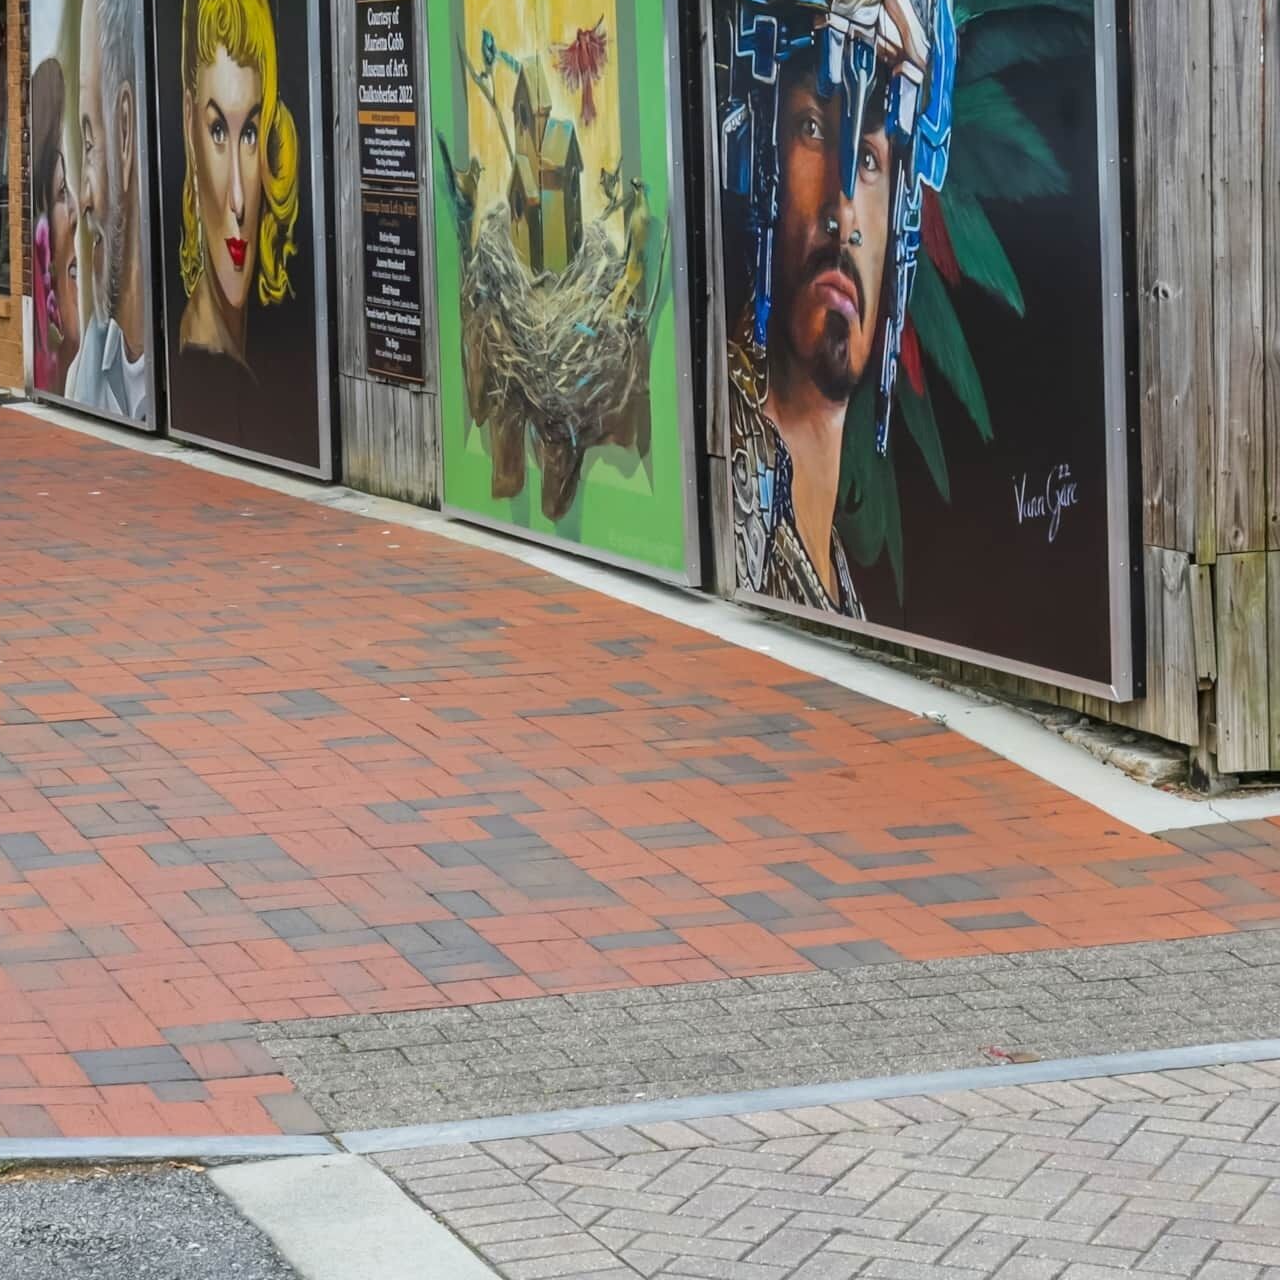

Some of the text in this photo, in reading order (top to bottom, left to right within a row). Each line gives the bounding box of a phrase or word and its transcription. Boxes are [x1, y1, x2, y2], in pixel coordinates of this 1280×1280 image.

[367, 6, 400, 29] Courtesy of
[364, 32, 404, 51] Marietta Cobb
[362, 59, 385, 77] Museum
[386, 58, 393, 77] of
[398, 85, 413, 103] 2022
